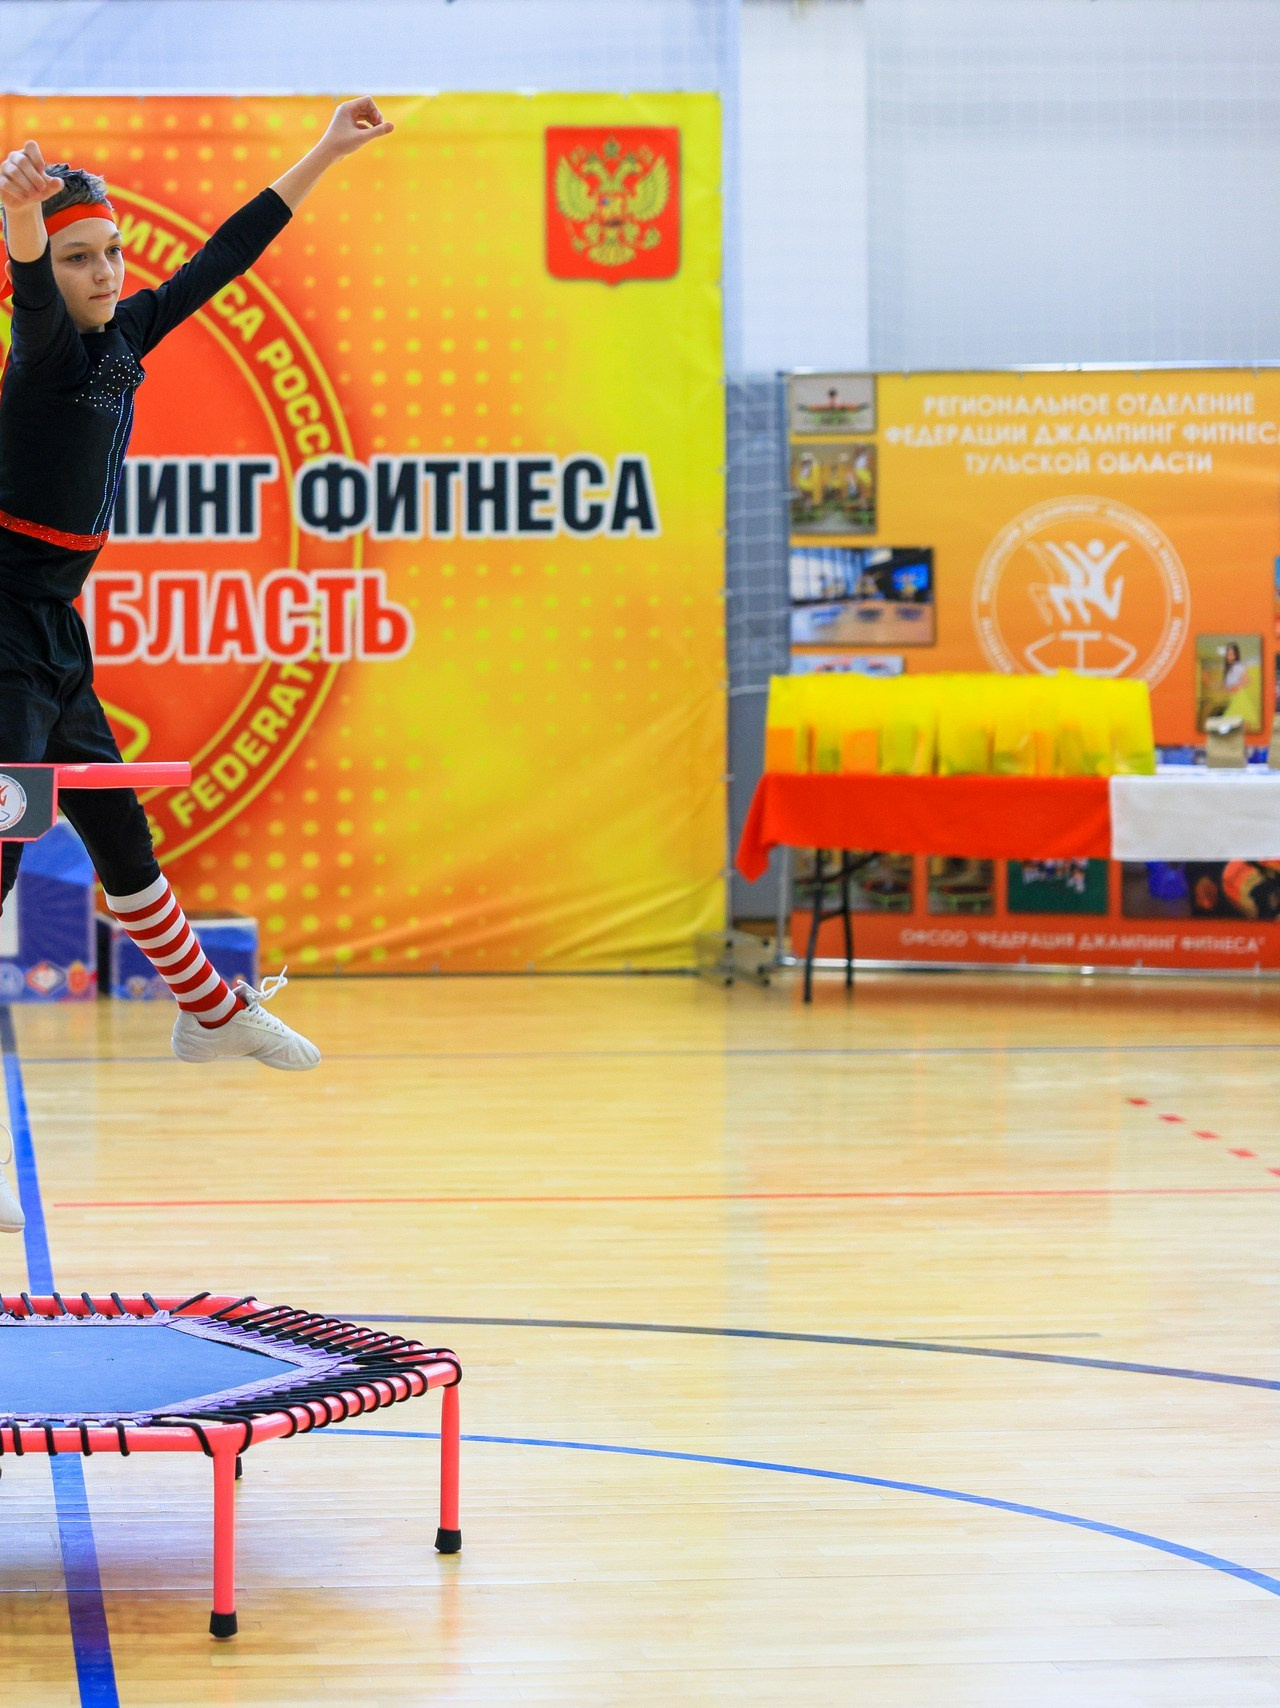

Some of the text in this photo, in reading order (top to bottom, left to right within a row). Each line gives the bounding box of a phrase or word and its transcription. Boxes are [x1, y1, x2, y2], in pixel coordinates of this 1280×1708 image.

[120, 213, 265, 342] ИТНСА
[256, 338, 331, 458] РОСС
[884, 421, 1280, 448] ФЕДЕРАЦИИ ДЖАМПИНГ ФИТНЕС
[923, 391, 1255, 417] РЕГИОНАЛЬНОЕ ОТДЕЛЕНИЕ
[294, 453, 661, 541] ФИТНЕСА
[964, 447, 1213, 475] ТУЛЬСКОЙ ОБЛАСТИ
[88, 568, 415, 665] БЛАСТЬ
[169, 655, 318, 828] FEDERAT
